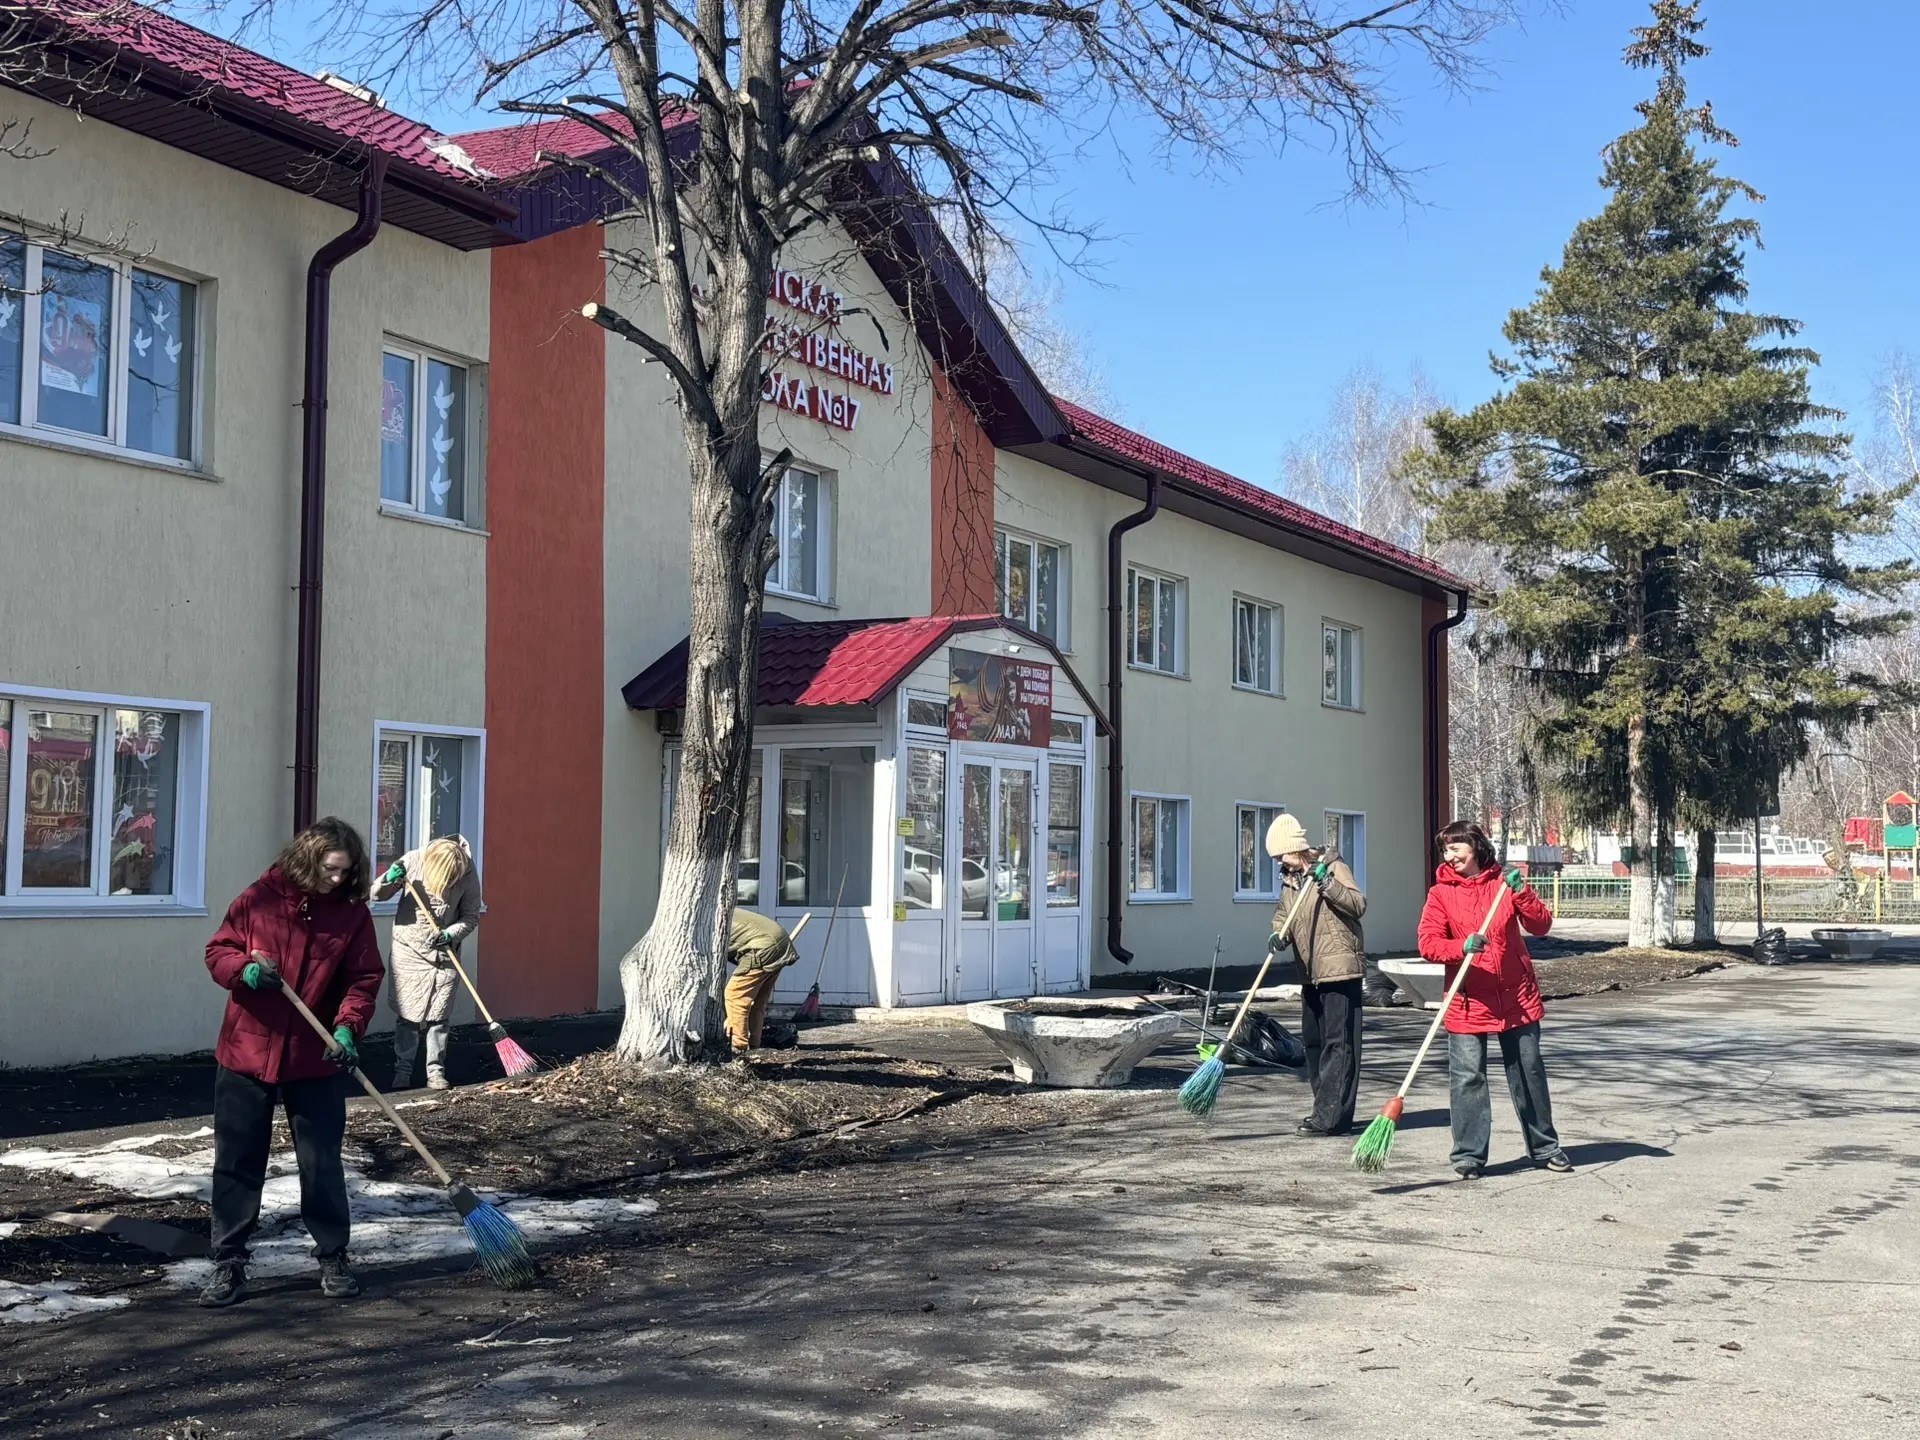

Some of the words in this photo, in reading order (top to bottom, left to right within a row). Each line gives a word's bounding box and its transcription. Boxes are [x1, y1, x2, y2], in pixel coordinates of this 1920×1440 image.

[956, 721, 968, 730] 1945
[996, 724, 1017, 740] МАЯ
[30, 768, 51, 810] 9
